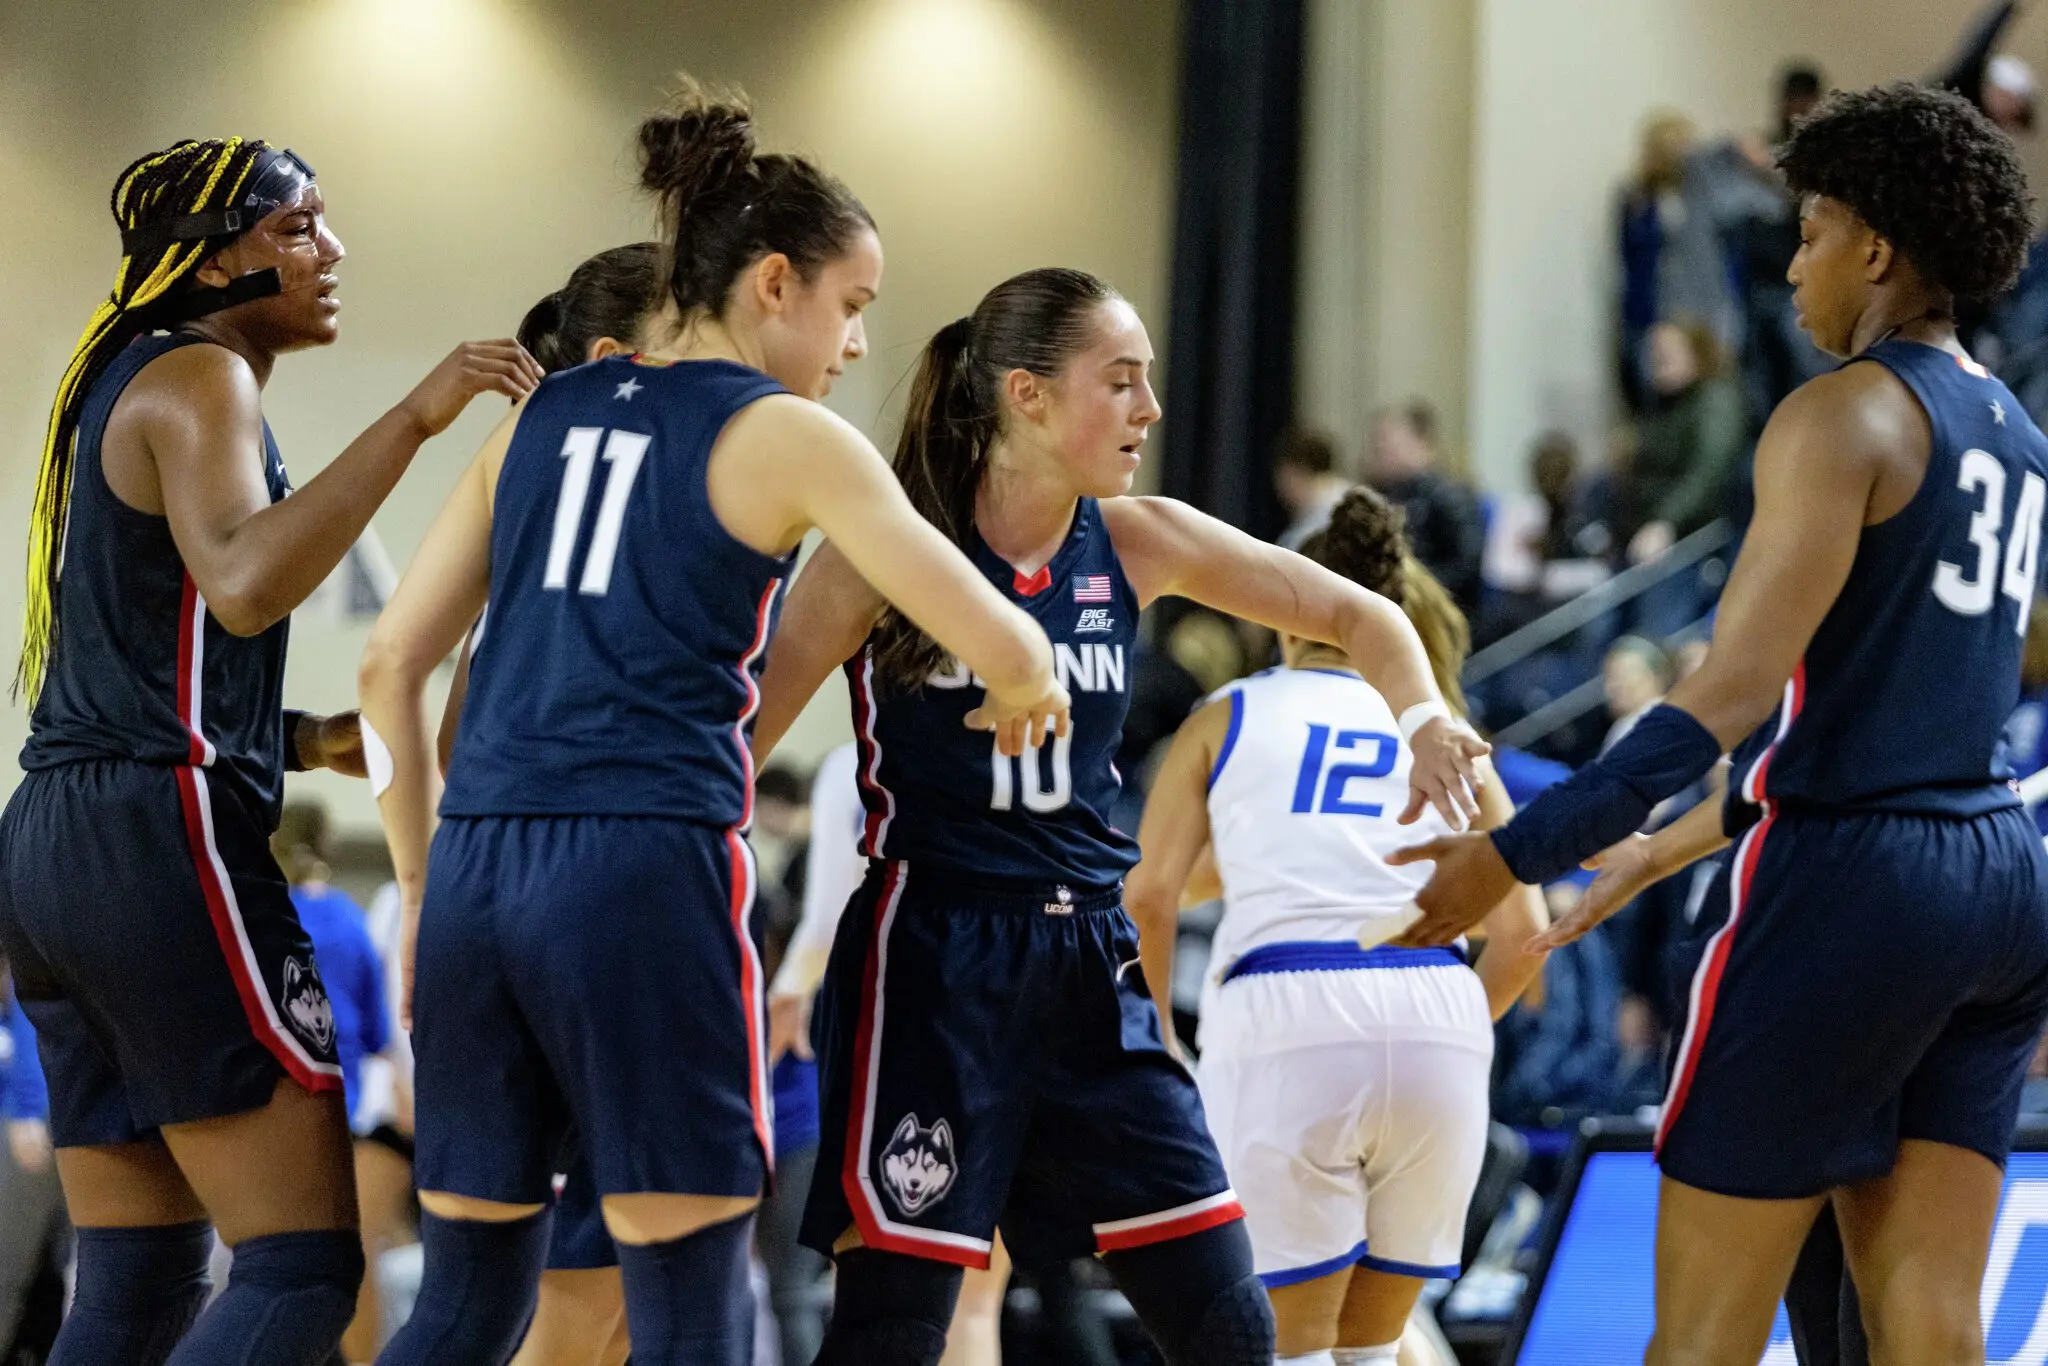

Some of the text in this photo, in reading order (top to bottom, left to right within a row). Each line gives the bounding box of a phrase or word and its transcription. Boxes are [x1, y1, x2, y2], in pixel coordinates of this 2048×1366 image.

[543, 426, 652, 596] 11
[1932, 448, 2047, 637] 34
[1075, 618, 1115, 628] EAST
[1080, 609, 1109, 619] BIG
[926, 643, 1125, 692] UNN
[990, 713, 1074, 812] 10
[1291, 722, 1398, 817] 12
